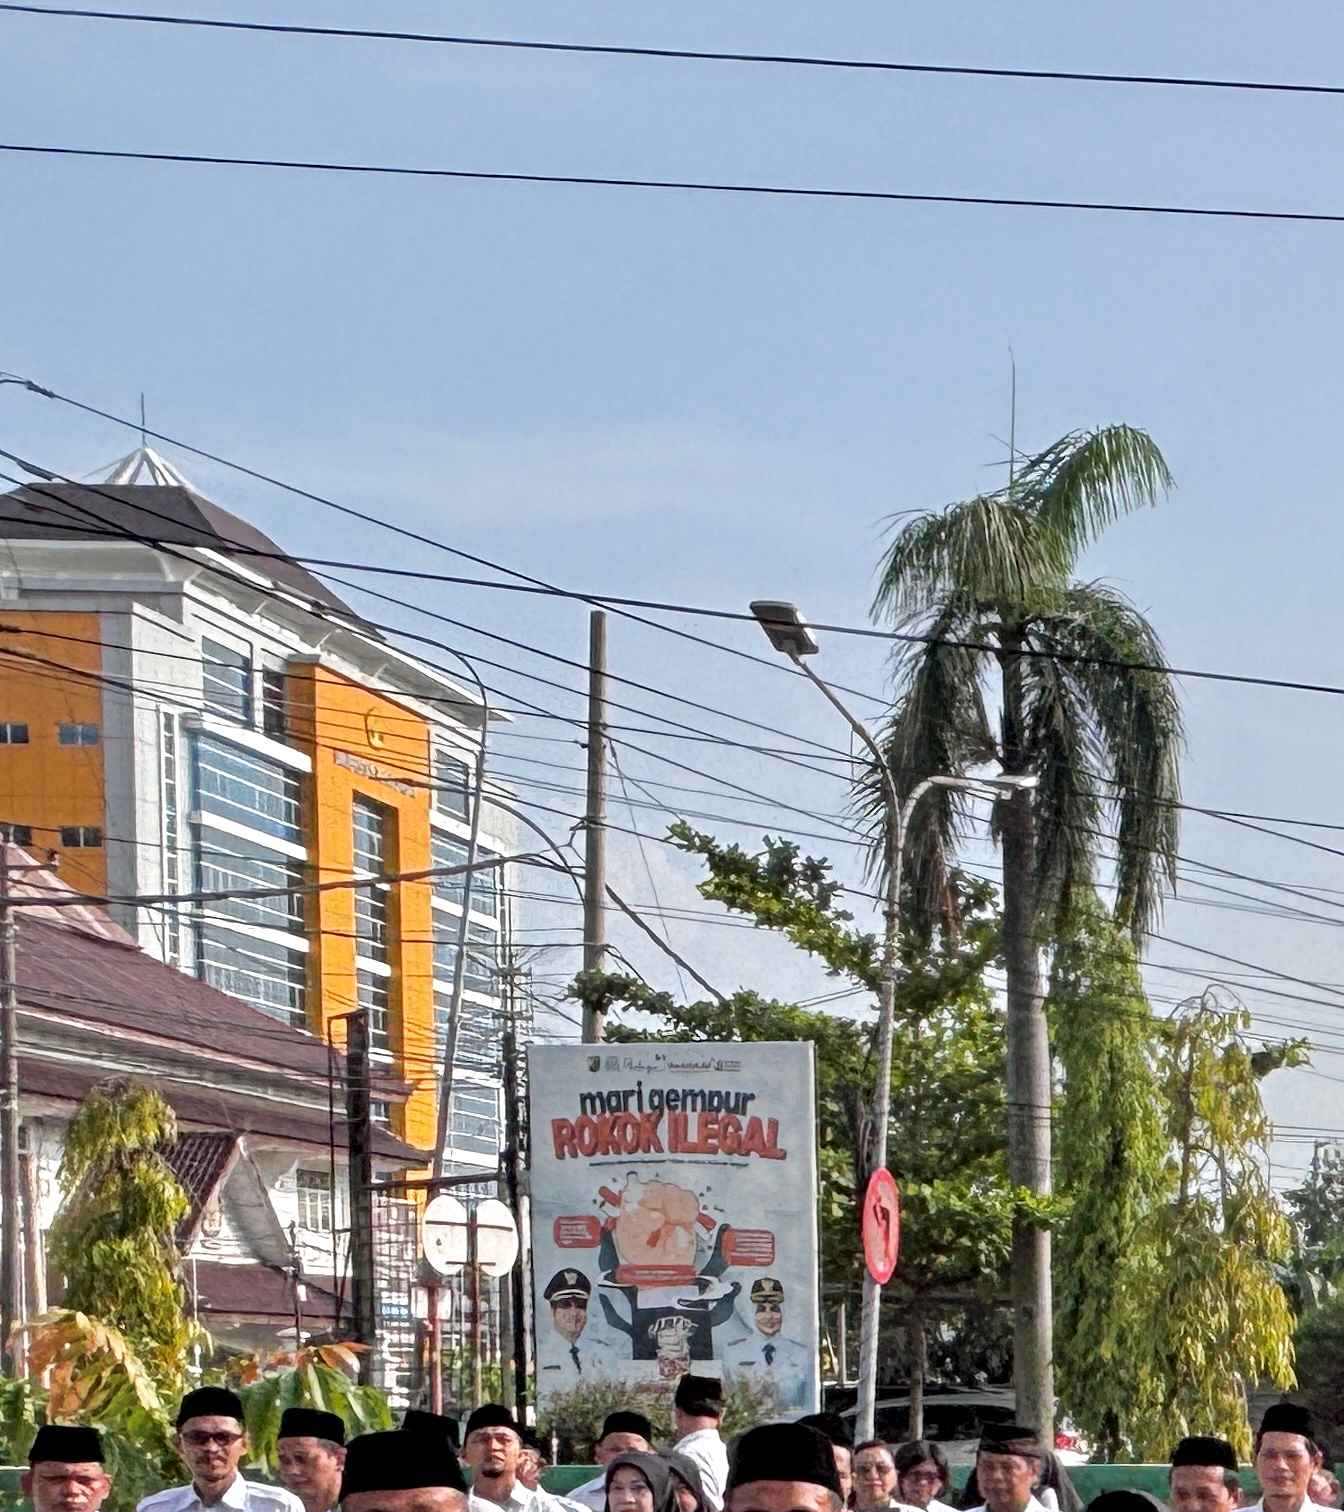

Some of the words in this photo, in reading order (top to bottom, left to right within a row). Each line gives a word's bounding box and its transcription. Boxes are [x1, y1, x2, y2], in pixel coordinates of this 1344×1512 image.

[579, 1080, 643, 1116] mari
[649, 1087, 756, 1118] gempur
[551, 1112, 664, 1160] ROKOK
[667, 1112, 787, 1160] ILEGAL
